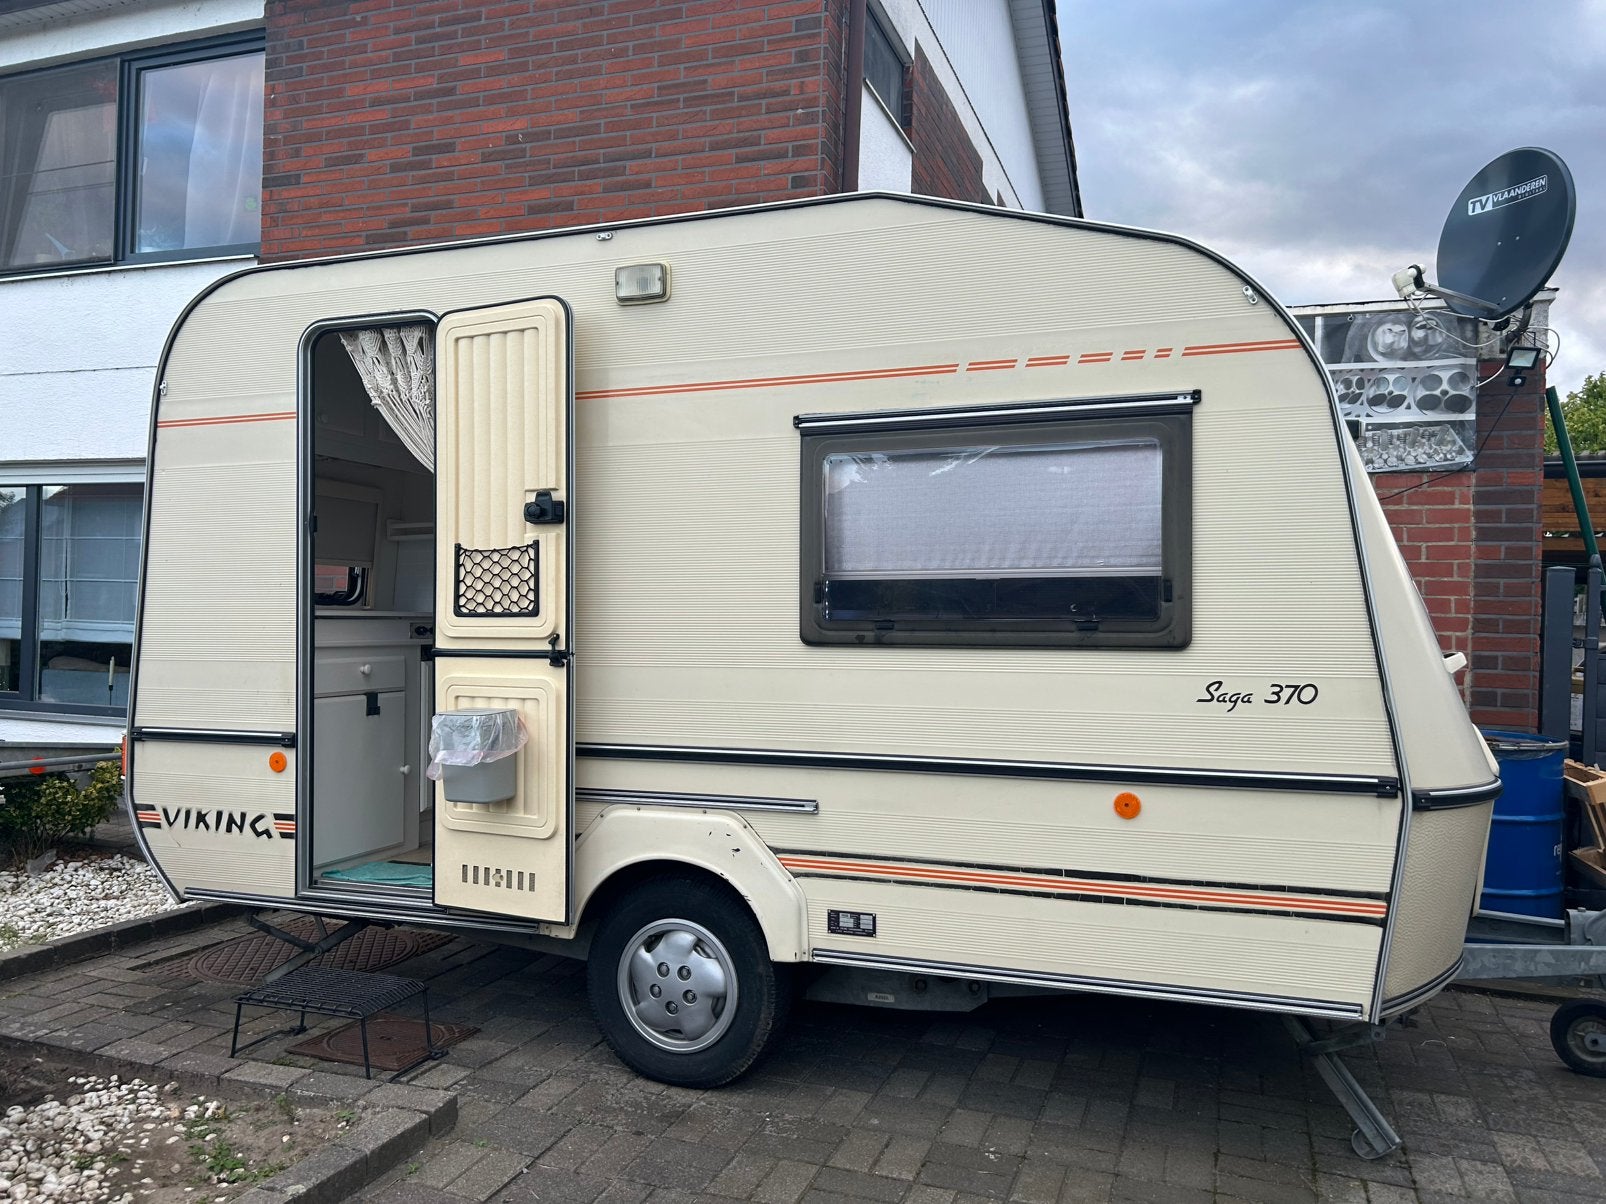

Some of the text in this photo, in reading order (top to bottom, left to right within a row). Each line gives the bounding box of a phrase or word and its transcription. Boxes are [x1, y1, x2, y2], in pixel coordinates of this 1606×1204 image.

[1470, 177, 1546, 214] TV VLAANDEREN
[1196, 680, 1319, 712] Saga 370
[162, 806, 273, 840] VIKING
